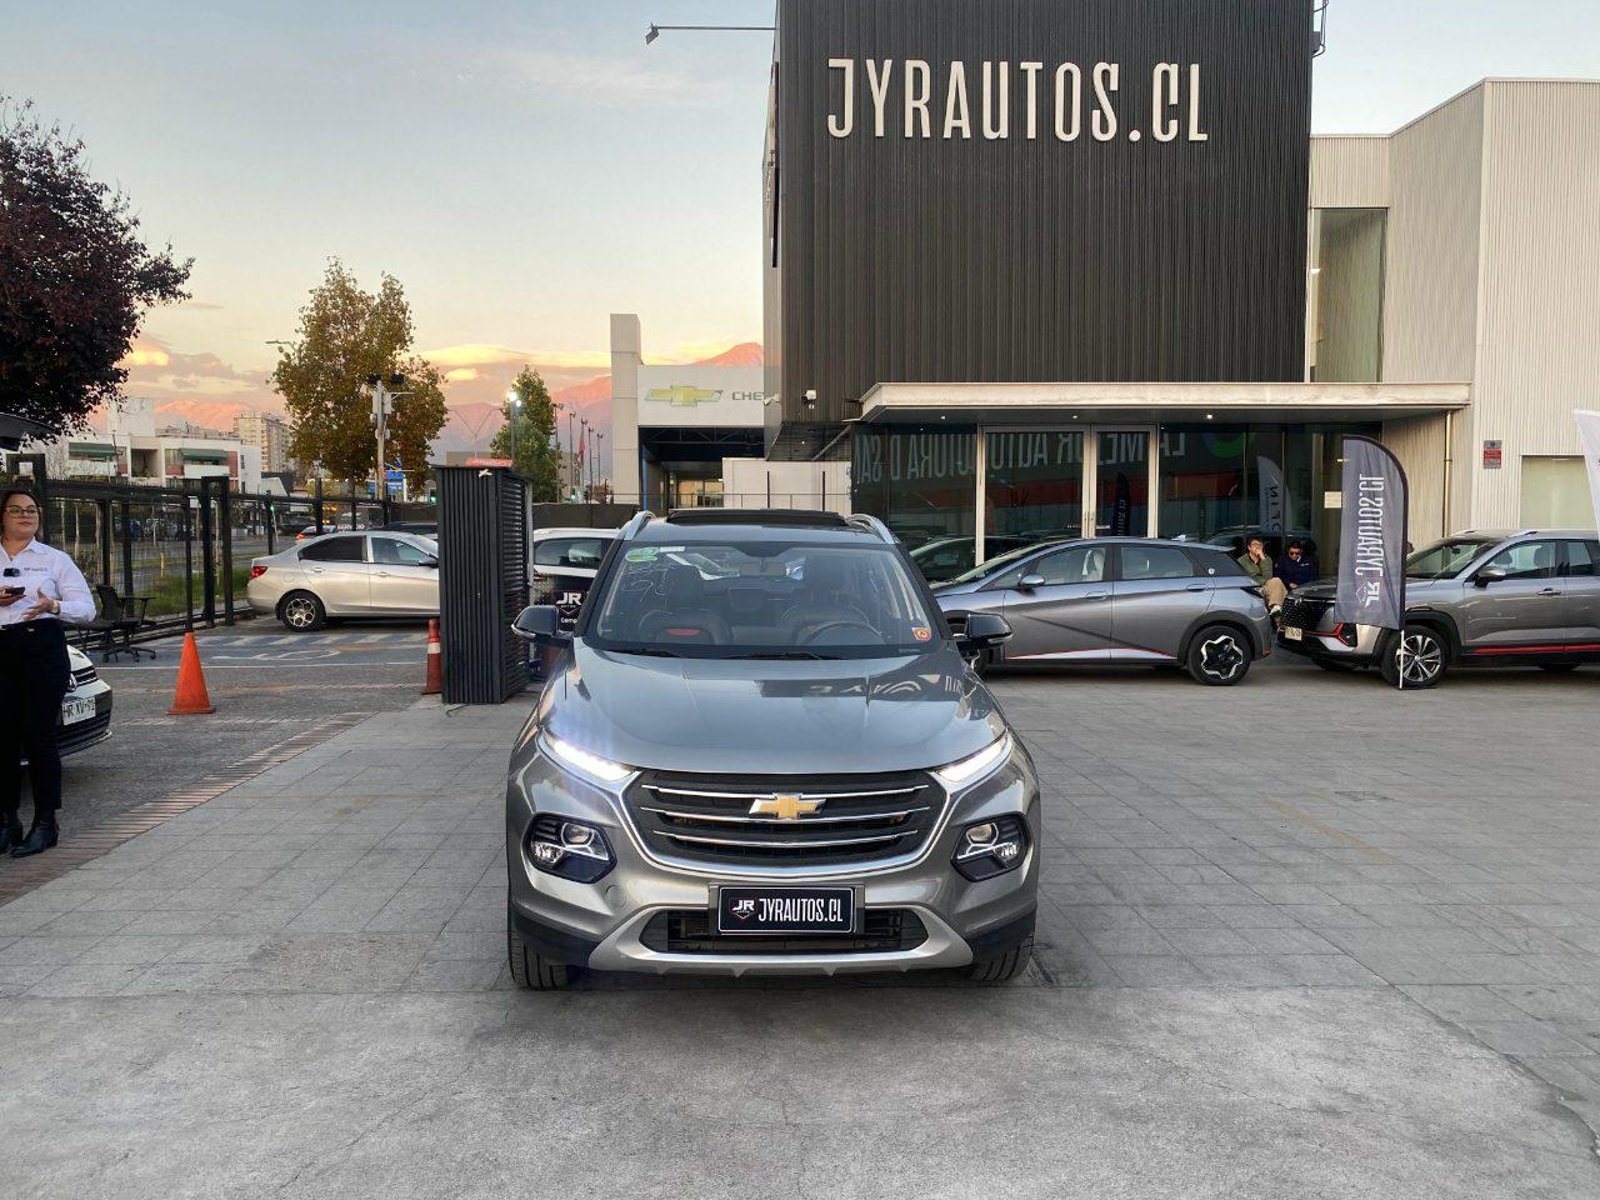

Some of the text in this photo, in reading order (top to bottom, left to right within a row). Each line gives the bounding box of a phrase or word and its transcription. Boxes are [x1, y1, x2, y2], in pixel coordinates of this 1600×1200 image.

[828, 58, 1208, 142] JYRAUTOS.CL
[556, 592, 582, 606] JR
[732, 898, 843, 922] JR JYRAUTOS.CL
